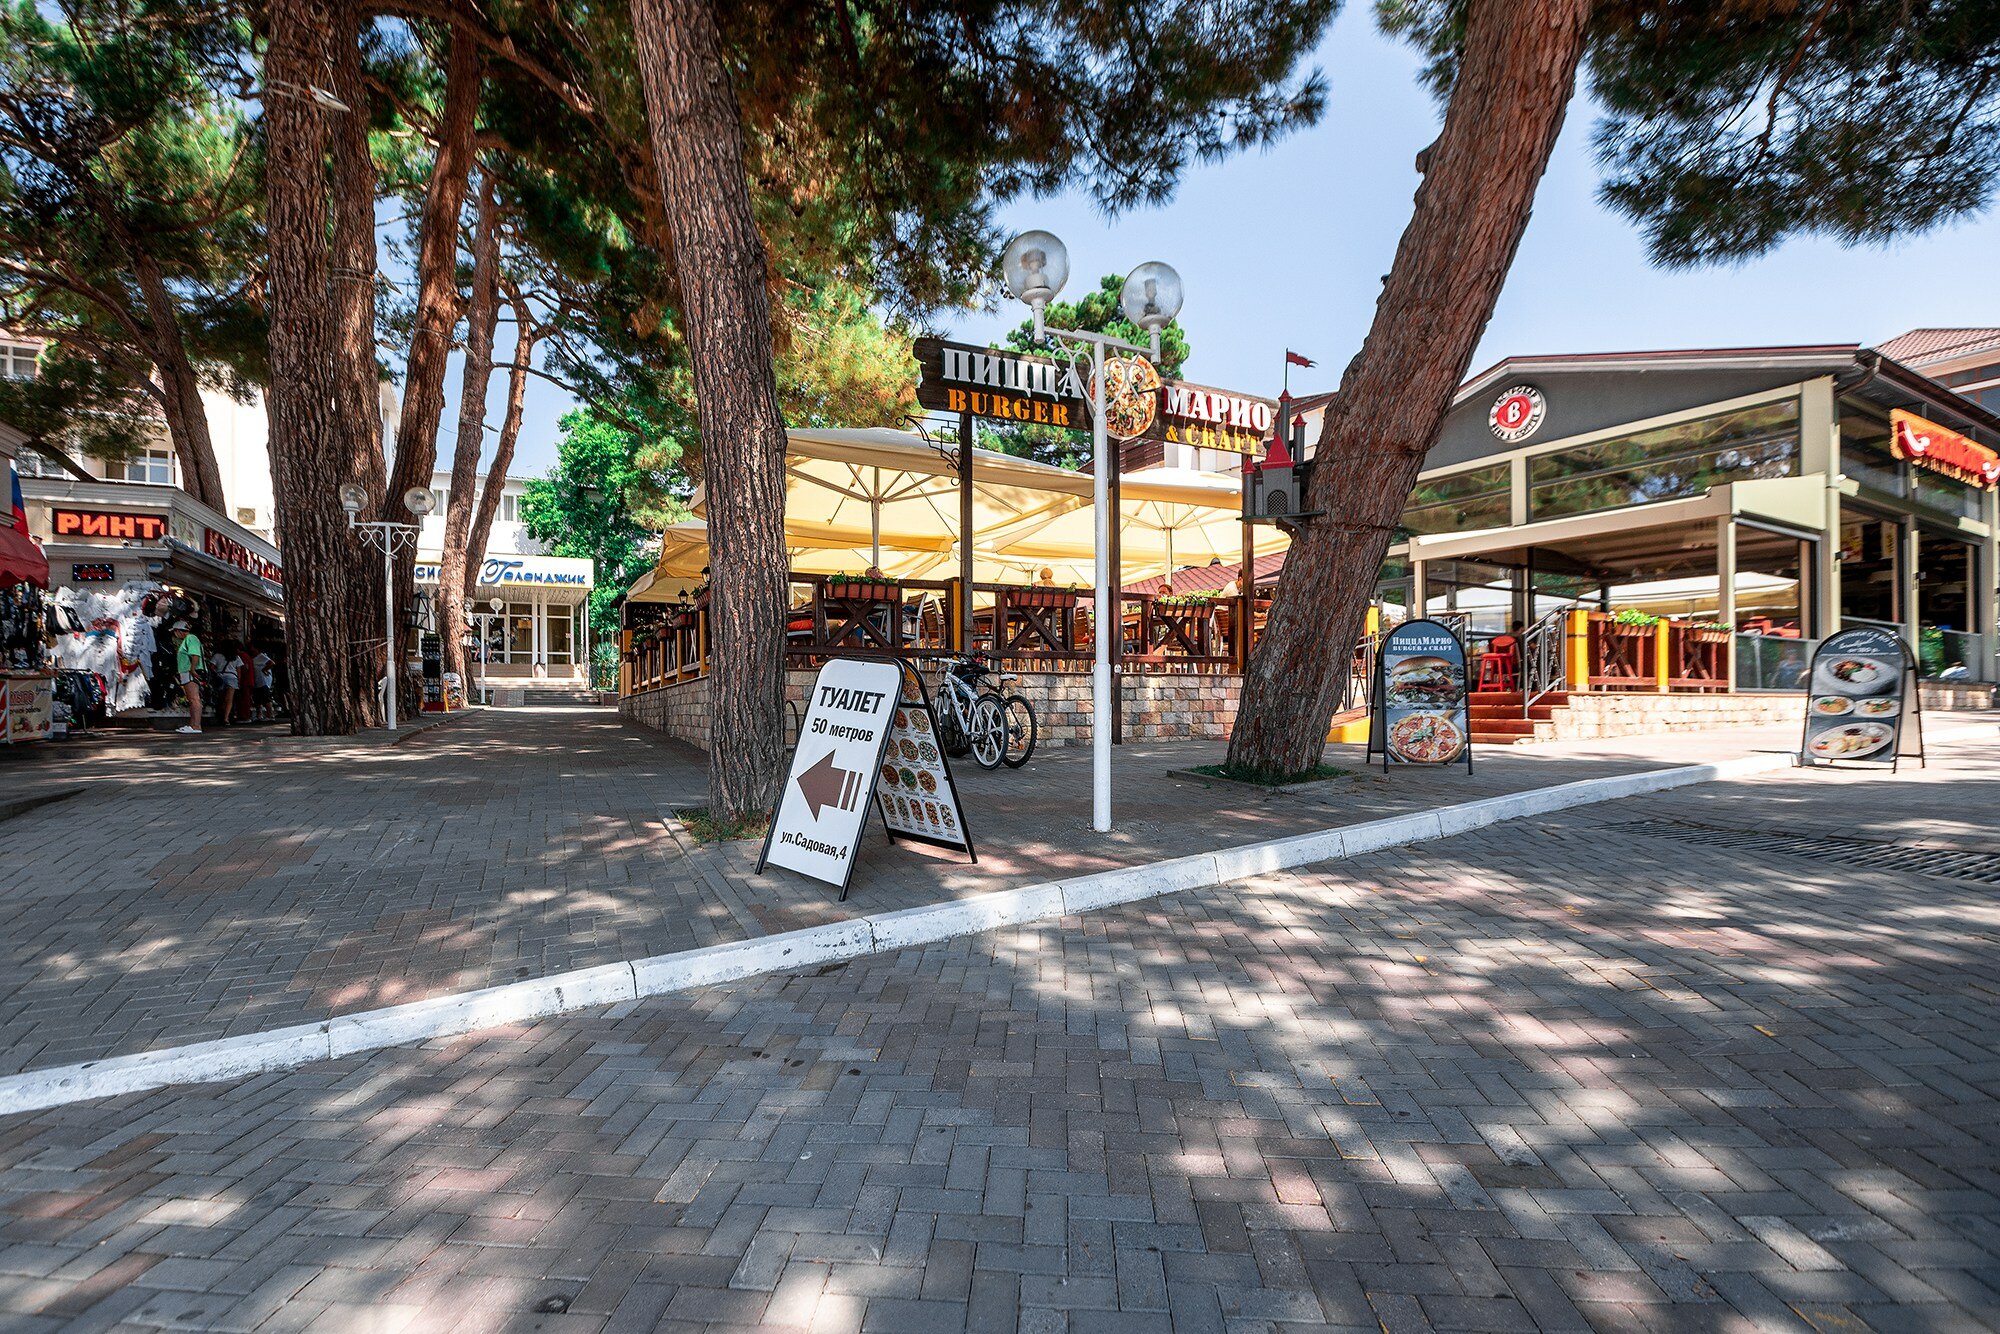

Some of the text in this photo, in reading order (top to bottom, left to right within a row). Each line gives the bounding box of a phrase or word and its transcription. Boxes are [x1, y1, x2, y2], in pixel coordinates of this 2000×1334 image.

[943, 348, 1083, 402] ПИЦЦА
[948, 389, 1070, 426] BURGER
[1163, 385, 1271, 431] МАРИО
[1166, 423, 1261, 455] & CRAFT
[819, 686, 885, 714] ТУАЛЕТ
[811, 718, 874, 743] 50 метров
